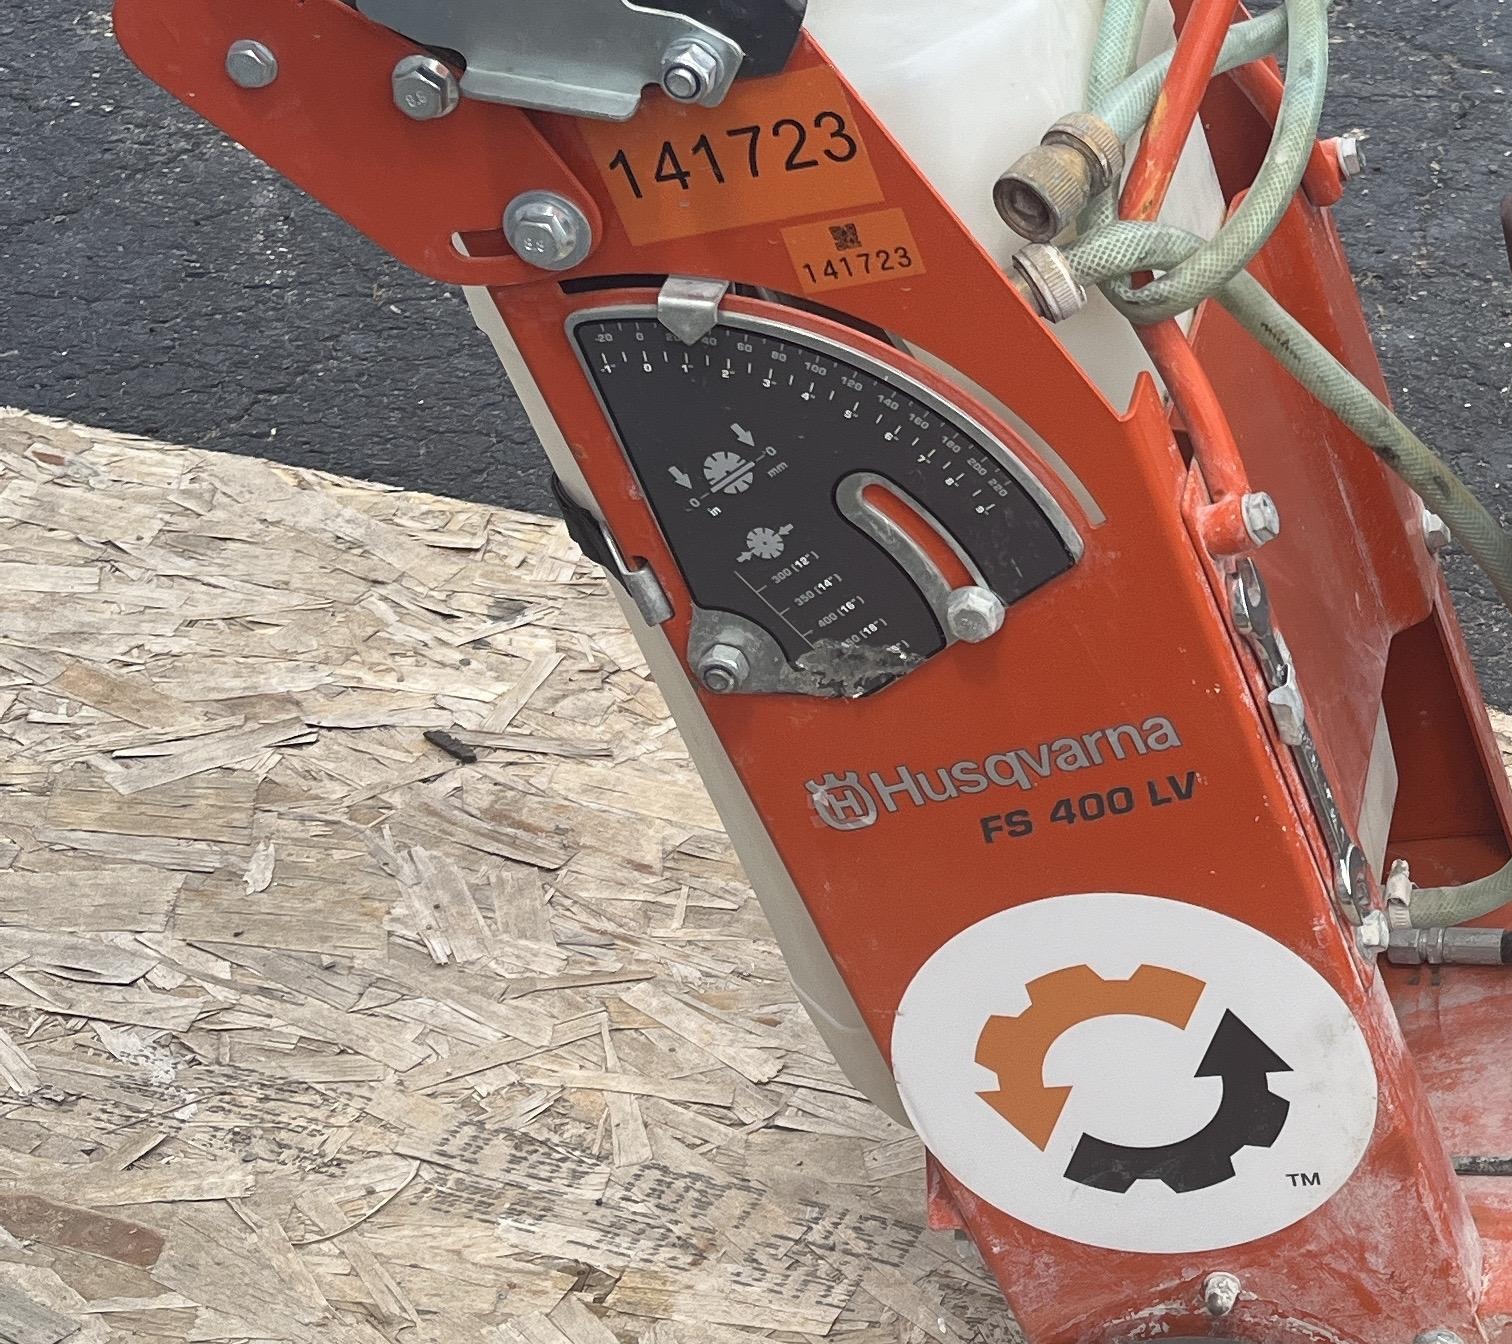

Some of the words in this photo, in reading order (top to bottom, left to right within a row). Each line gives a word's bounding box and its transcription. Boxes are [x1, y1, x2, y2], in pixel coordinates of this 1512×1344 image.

[607, 111, 859, 199] 141723
[803, 246, 913, 284] 141723
[804, 361, 828, 377] 100
[840, 376, 864, 392] 120
[876, 394, 900, 411] 140
[908, 413, 930, 430] 160
[941, 435, 962, 454] 180
[966, 457, 988, 476] 200
[987, 478, 1008, 497] 220
[767, 461, 789, 479] mm
[707, 506, 722, 517] in
[771, 567, 793, 585] 300
[794, 590, 815, 607] 350
[818, 612, 839, 628] 400
[868, 714, 1183, 813] Husqvarna
[979, 809, 1034, 845] FS
[1049, 785, 1135, 826] 400
[1146, 770, 1198, 808] LV
[1284, 1172, 1321, 1187] TM
